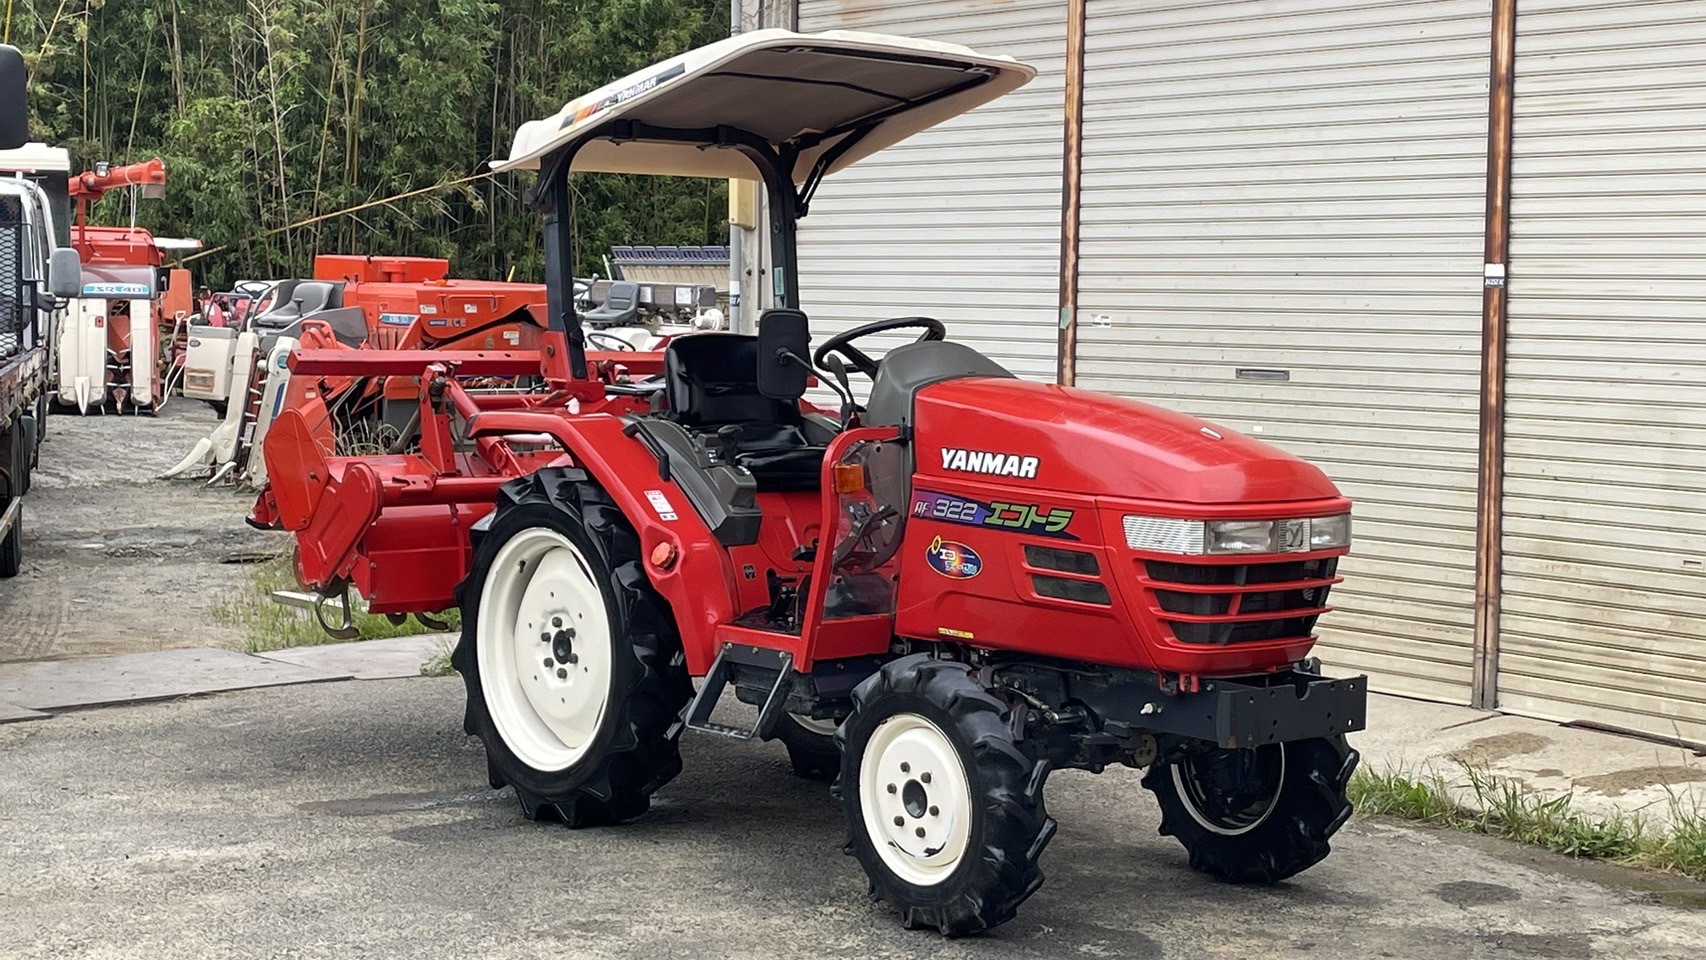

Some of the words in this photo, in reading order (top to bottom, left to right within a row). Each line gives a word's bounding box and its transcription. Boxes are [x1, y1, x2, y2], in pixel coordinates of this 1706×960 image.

[617, 77, 657, 102] YANMAR
[941, 448, 1040, 478] YANMAR
[933, 499, 978, 521] 322
[984, 502, 1074, 532] エコトラ
